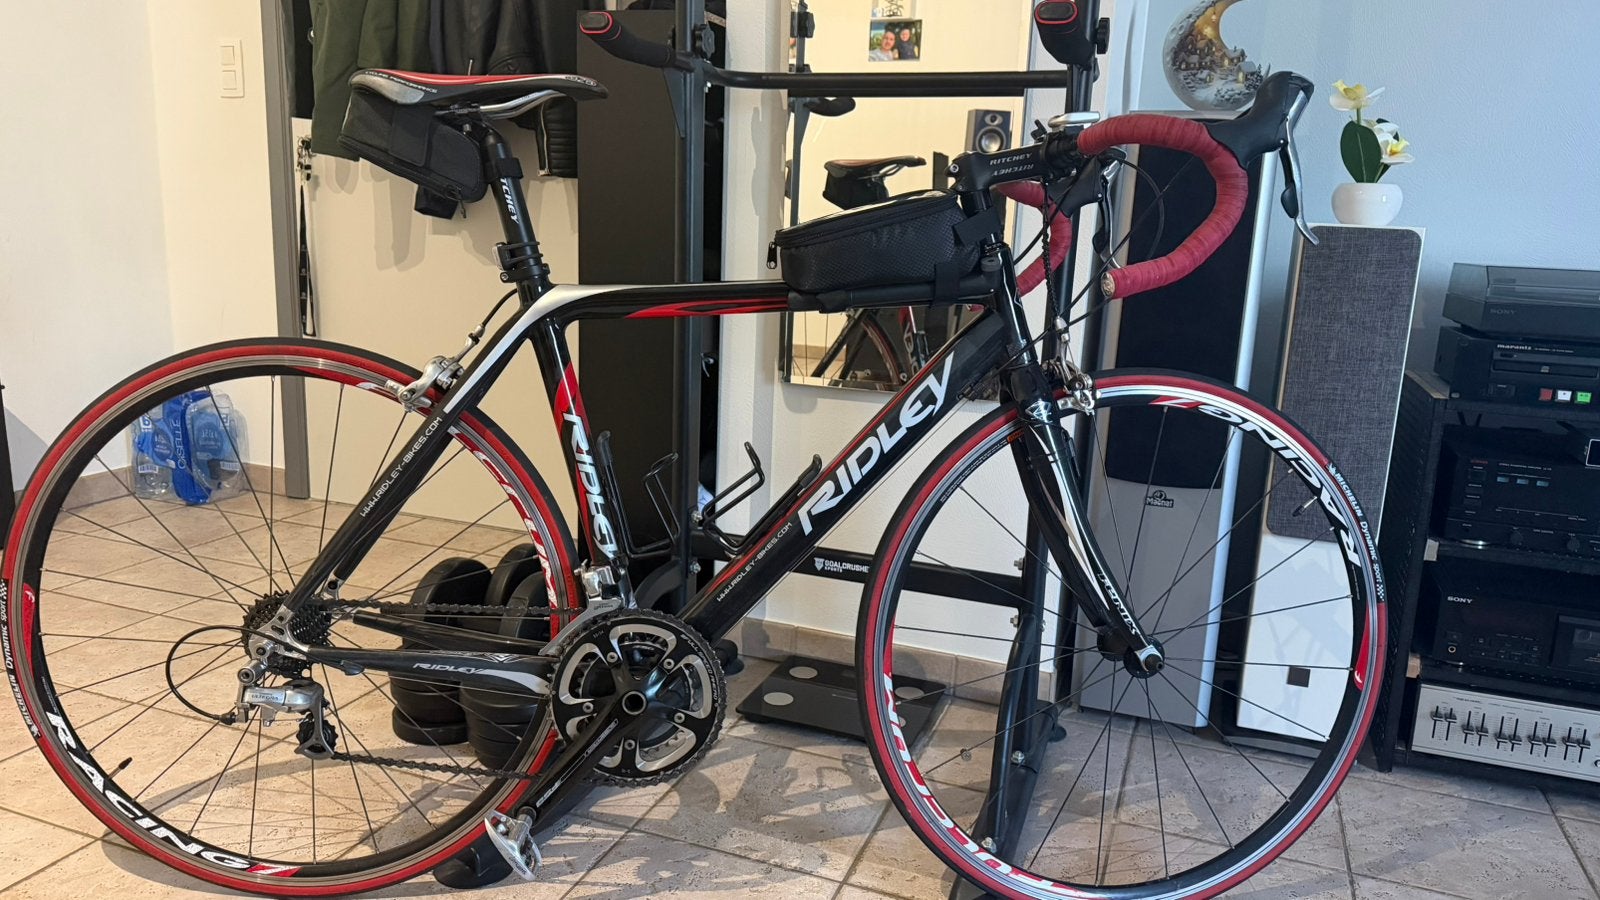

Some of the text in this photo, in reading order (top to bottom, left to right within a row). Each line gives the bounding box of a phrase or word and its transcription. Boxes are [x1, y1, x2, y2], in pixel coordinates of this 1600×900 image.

[989, 152, 1033, 166] RITCHEY
[991, 163, 1034, 177] RITCHEY
[500, 177, 519, 225] TCHEY
[360, 417, 443, 518] WWW.RIDLEY-BIKES.COM
[797, 351, 954, 537] RIDLEY
[563, 412, 618, 560] RIDLEY
[1198, 405, 1362, 568] RACING
[1335, 472, 1383, 583] MICHELIN Dynamic sport
[716, 522, 793, 602] WWW.RIDLEY-BIKES.COM
[824, 560, 870, 573] GOALCRUSHE
[1447, 596, 1473, 604] SONY
[1, 623, 14, 669] Dynamic
[413, 662, 484, 675] RIDLEY
[9, 673, 33, 724] MICHELIN
[45, 711, 252, 869] RACING
